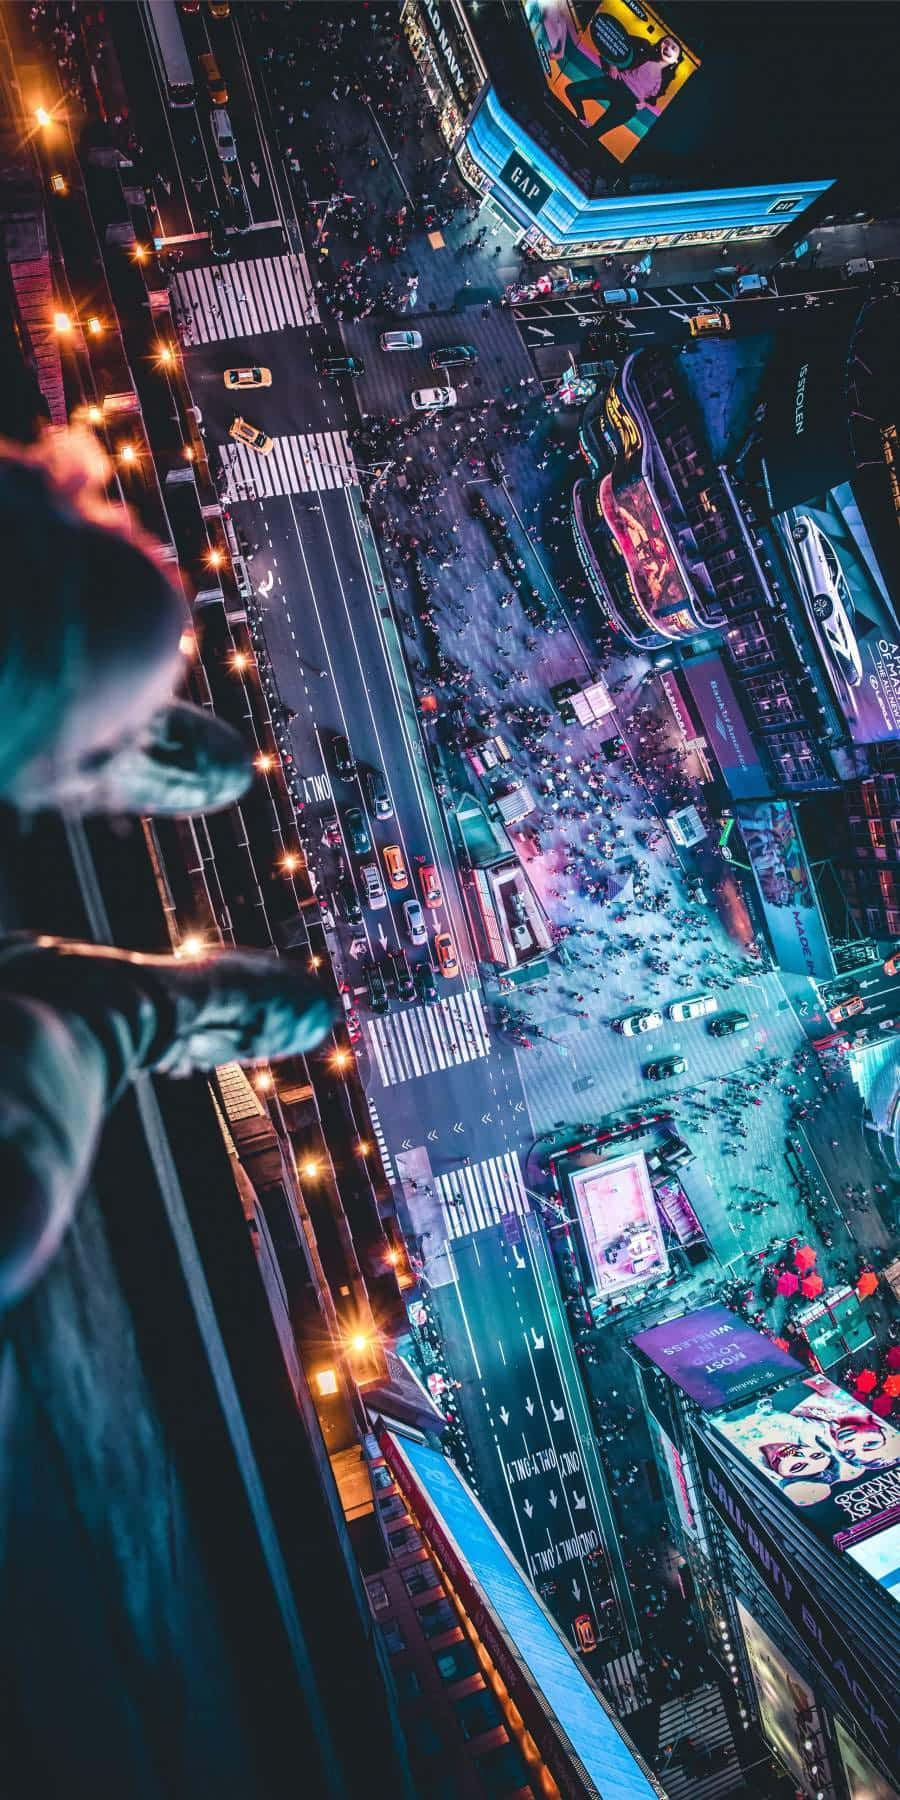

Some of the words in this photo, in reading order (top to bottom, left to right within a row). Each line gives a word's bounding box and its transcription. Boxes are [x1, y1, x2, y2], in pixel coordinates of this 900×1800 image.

[438, 28, 464, 87] NAVY
[511, 166, 540, 199] GAP
[795, 377, 806, 435] STOLEN
[879, 639, 893, 660] OF
[710, 680, 725, 710] Bank
[726, 723, 749, 772] America
[303, 774, 331, 803] ONLY
[792, 911, 812, 957] MADE
[805, 959, 817, 976] IN
[663, 1323, 734, 1356] WIRELESS
[704, 1351, 747, 1374] MOST
[506, 1456, 532, 1485] ONLY
[531, 1447, 558, 1475] ONLY
[558, 1449, 581, 1478] ONLY
[530, 1547, 556, 1577] ONLY
[707, 1467, 745, 1534] CALL
[747, 1523, 793, 1601] DUTY
[801, 1602, 890, 1746] BLACK
